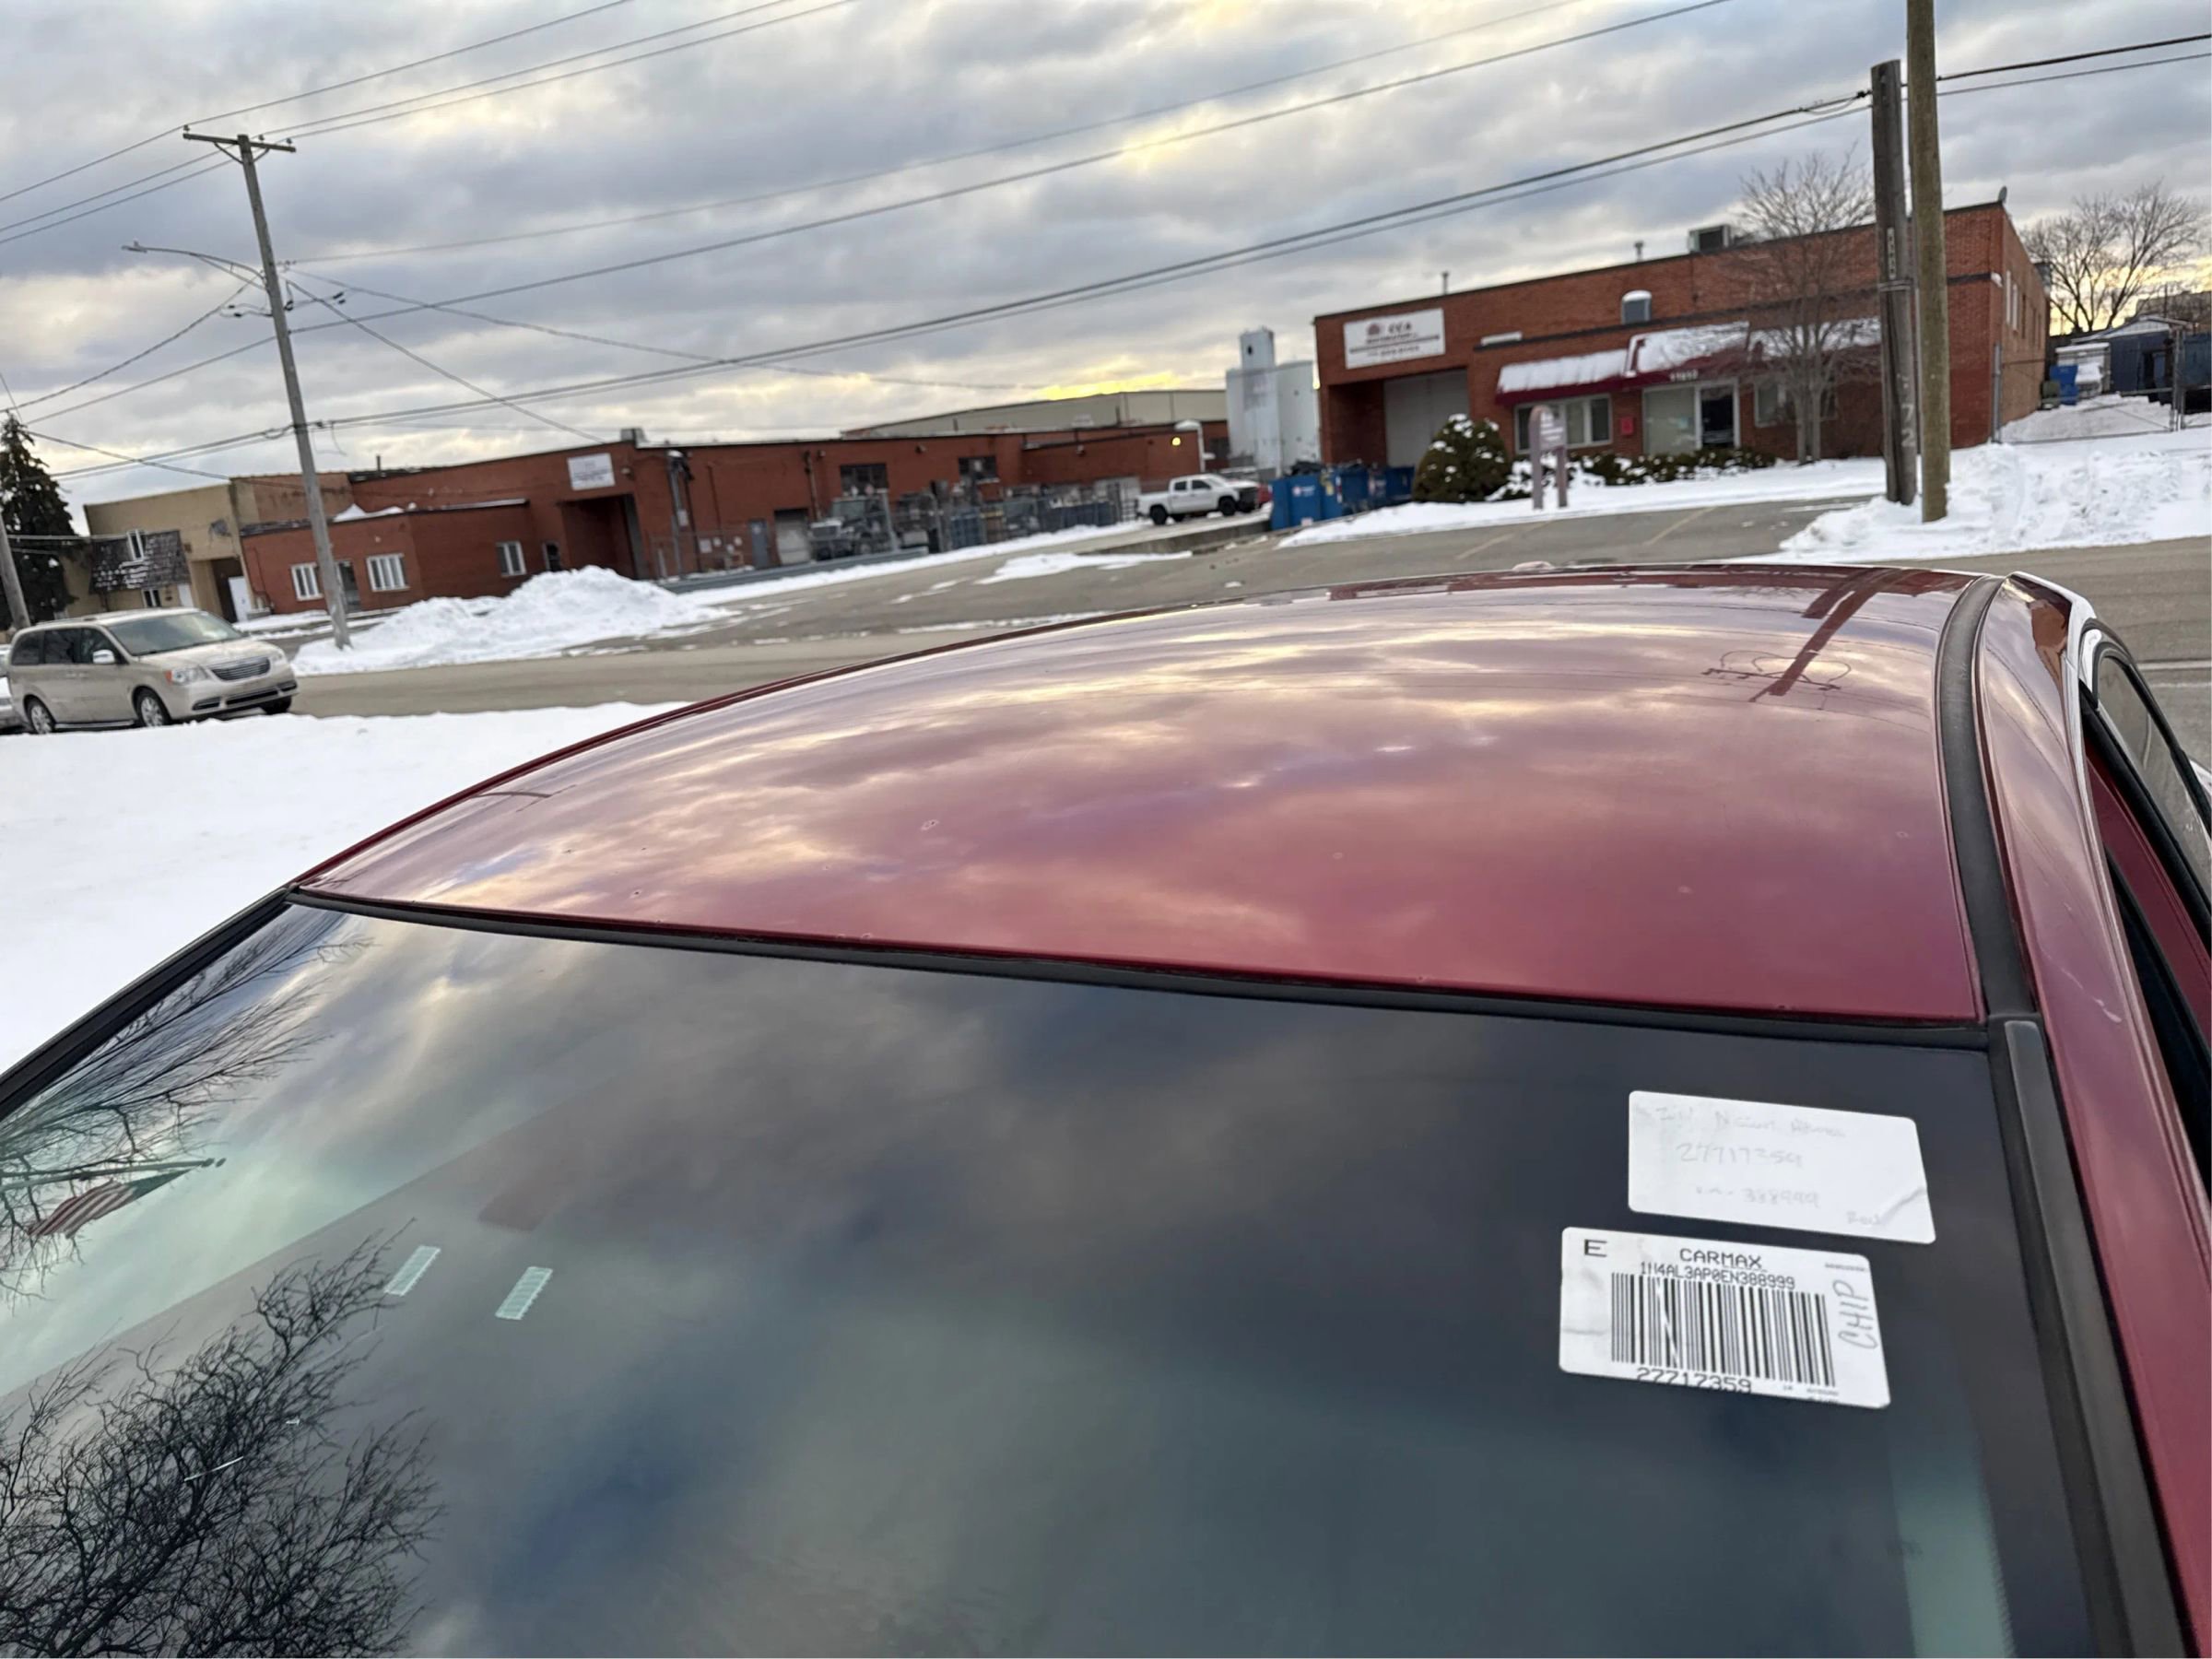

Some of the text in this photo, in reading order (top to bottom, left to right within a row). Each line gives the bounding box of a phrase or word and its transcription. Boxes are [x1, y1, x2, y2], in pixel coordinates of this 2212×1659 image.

[1676, 1143, 1802, 1168] 27717359
[1583, 1239, 1607, 1257] E
[1679, 1247, 1762, 1269] CARMAX
[1831, 1278, 1878, 1349] CHIP
[1637, 1367, 1751, 1394] 27717359
